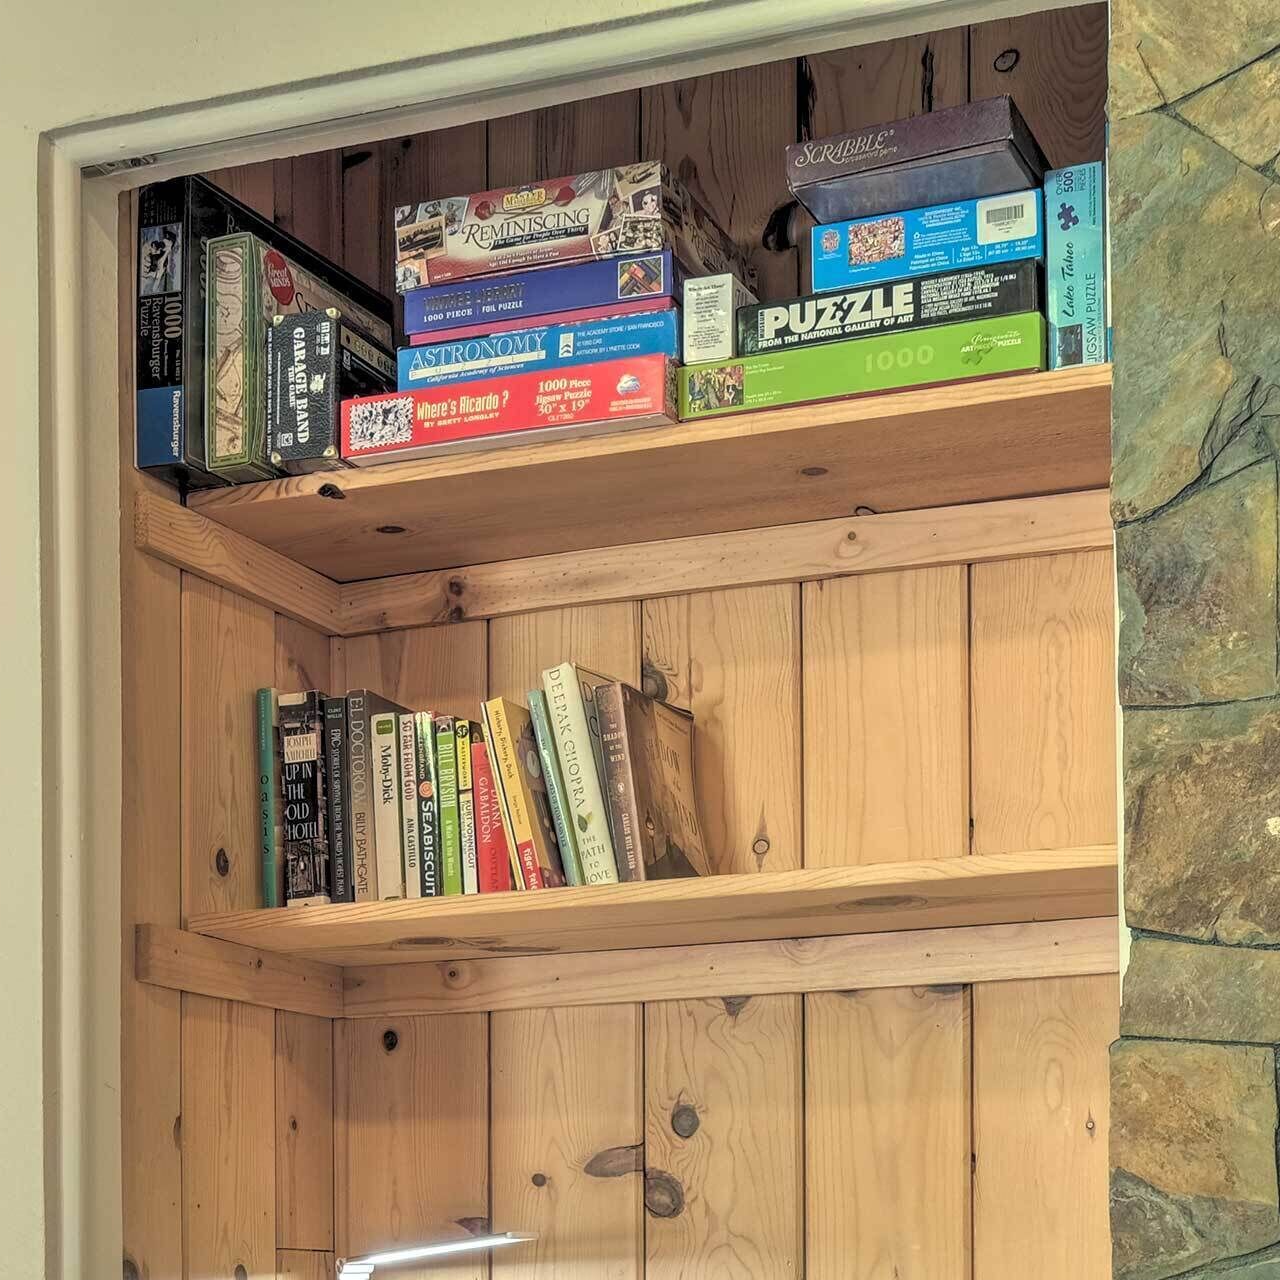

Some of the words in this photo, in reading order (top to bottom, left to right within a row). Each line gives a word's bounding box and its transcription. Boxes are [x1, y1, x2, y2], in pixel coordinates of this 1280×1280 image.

[795, 131, 888, 167] SCRABBLE
[1063, 171, 1074, 193] 500
[461, 208, 590, 250] REMINISCING
[1085, 272, 1096, 312] PUZZLE
[140, 298, 151, 336] Puzzle
[164, 293, 182, 338] 1000
[423, 311, 443, 322] 1000
[446, 309, 472, 319] PIECE
[482, 304, 496, 313] FOIL
[498, 300, 523, 311] PUZZLE
[765, 282, 914, 339] PUZZLE
[149, 296, 163, 381] Ravensburger
[758, 338, 782, 348] FROM
[784, 333, 799, 344] THE
[801, 325, 842, 341] NATIONAL
[844, 319, 881, 333] GALLERY
[884, 317, 895, 326] OF
[897, 314, 914, 323] ART
[1086, 316, 1098, 362] JIGSAW
[293, 327, 308, 395] GARAGE
[410, 332, 547, 370] ASTRONOMY
[864, 344, 935, 373] 1000
[535, 394, 562, 406] Jigsaw
[563, 388, 592, 399] Puzzle
[538, 378, 567, 393] 1000
[569, 379, 591, 388] Piece
[297, 397, 310, 443] BAND
[417, 397, 456, 420] Where's
[460, 393, 499, 415] Ricardo
[171, 390, 181, 457] Ravensburger
[402, 720, 412, 732] SO
[457, 728, 467, 736] SF
[549, 669, 572, 735] DEEPAK
[564, 740, 585, 808] CHOPRA
[403, 753, 414, 778] FROM
[440, 744, 454, 763] BILL
[286, 763, 299, 780] UP
[303, 762, 312, 779] IN
[380, 744, 394, 805] Moby-Dick
[287, 783, 305, 800] THE
[404, 779, 416, 801] GOD
[440, 768, 456, 808] BRYSON
[287, 803, 309, 820] OLD
[355, 812, 366, 836] BILLY
[464, 800, 472, 820] KURT
[479, 777, 492, 842] GABALDON
[491, 790, 501, 829] DIANA
[622, 812, 632, 835] CARLOS
[288, 822, 318, 840] HOTEL
[582, 835, 597, 844] THE
[408, 835, 416, 868] CASTILLO
[422, 800, 435, 896] SEABISCUIT
[524, 848, 534, 871] tiger
[581, 844, 606, 860] PATH
[356, 838, 368, 894] BATHGATE
[589, 861, 600, 869] TO
